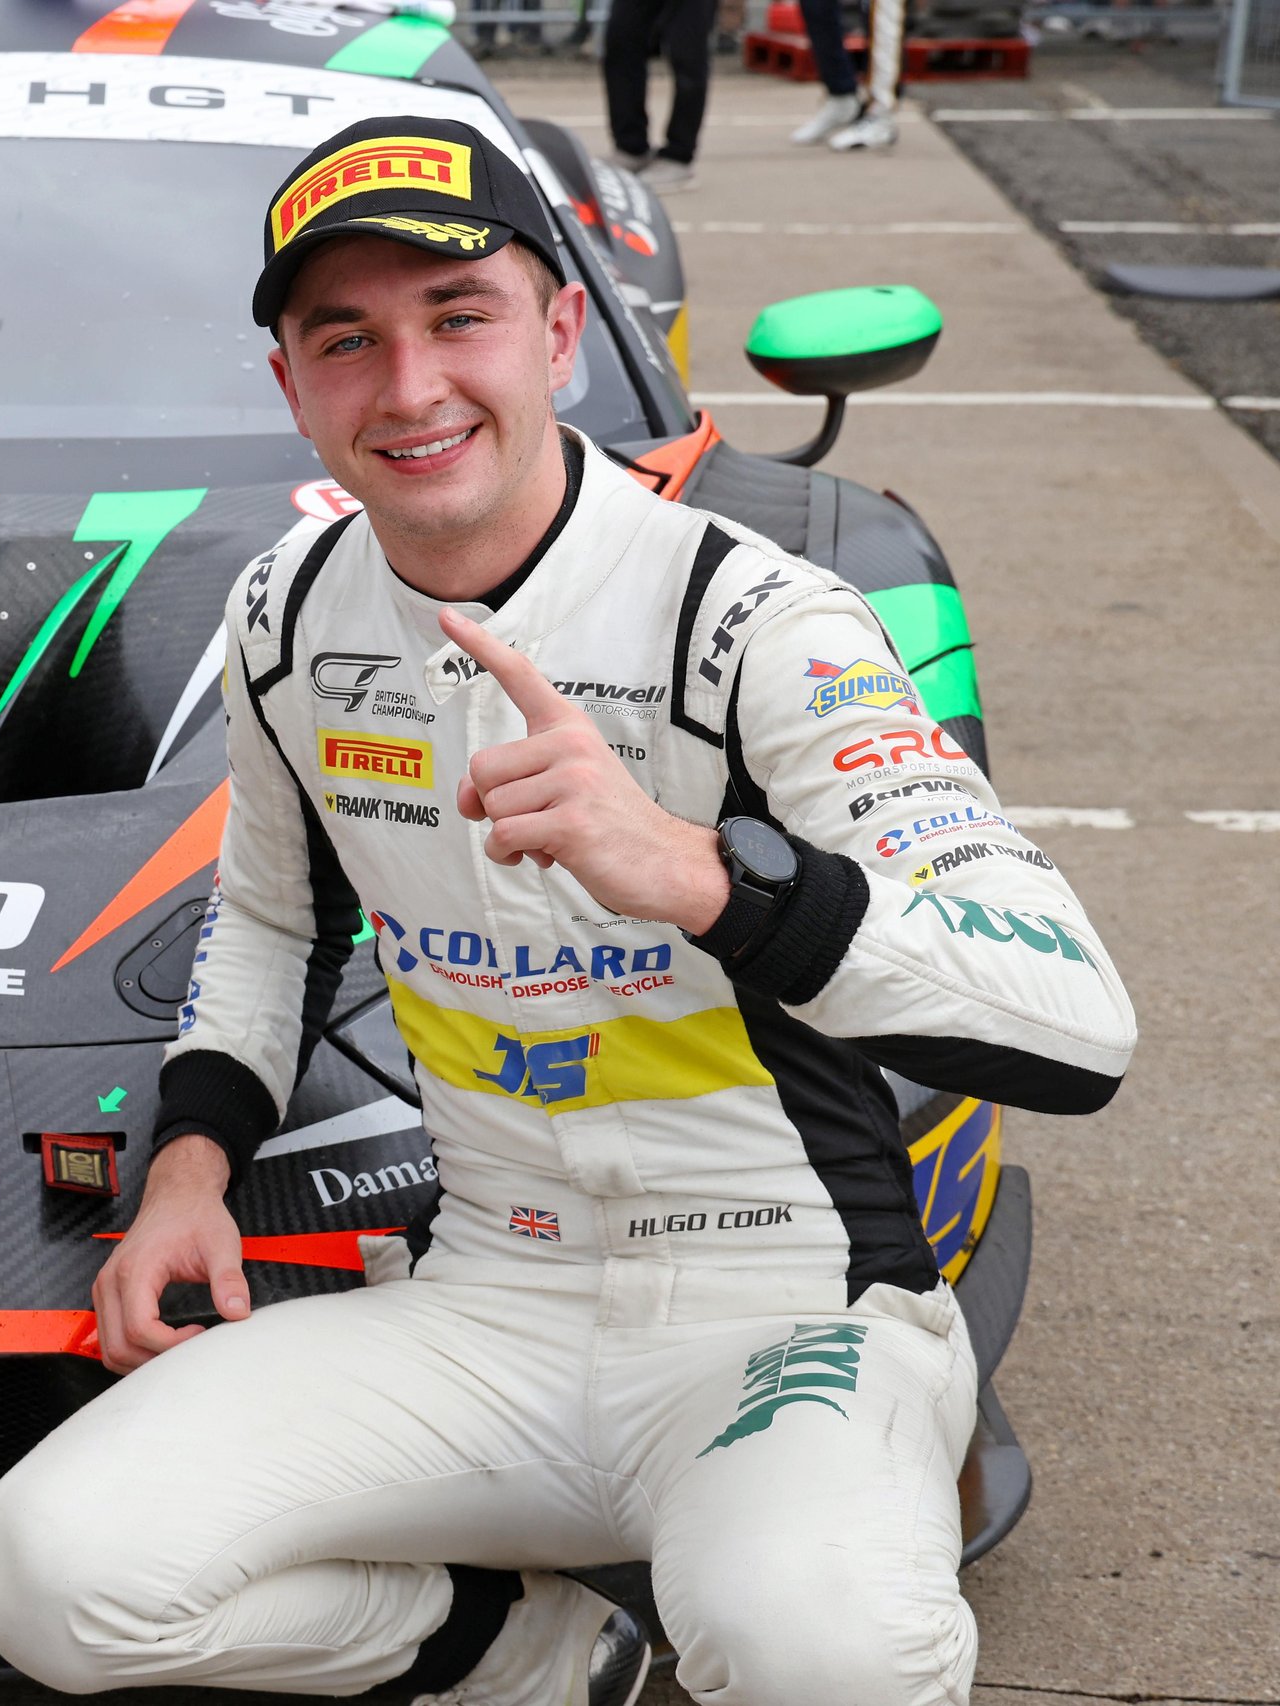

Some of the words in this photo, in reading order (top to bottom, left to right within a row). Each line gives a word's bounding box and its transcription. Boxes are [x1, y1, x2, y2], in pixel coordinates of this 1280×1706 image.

[279, 145, 452, 239] PIRELLI
[698, 569, 794, 687] HRX
[375, 690, 408, 705] BRITISH
[409, 696, 417, 707] GT
[550, 680, 667, 703] arwell
[820, 675, 913, 712] SUNOCO
[371, 703, 436, 725] CHAMPIONSHIP
[583, 704, 657, 720] MOTORSPORT
[325, 738, 423, 779] PIRELLI
[847, 763, 940, 789] MOTORSPORTS
[946, 765, 979, 776] GROUP
[336, 794, 382, 819] FRANK
[383, 800, 440, 828] THOMAS
[920, 825, 963, 842] DEMOLISH
[969, 818, 1002, 829] DISPOS
[931, 842, 994, 876] FRANK
[991, 843, 1055, 870] THOMAS
[429, 962, 503, 990] DEMOLISH
[511, 975, 589, 998] DISPOSE
[308, 1156, 438, 1208] Dama
[629, 1213, 707, 1237] HUGO
[718, 1203, 793, 1230] COOK
